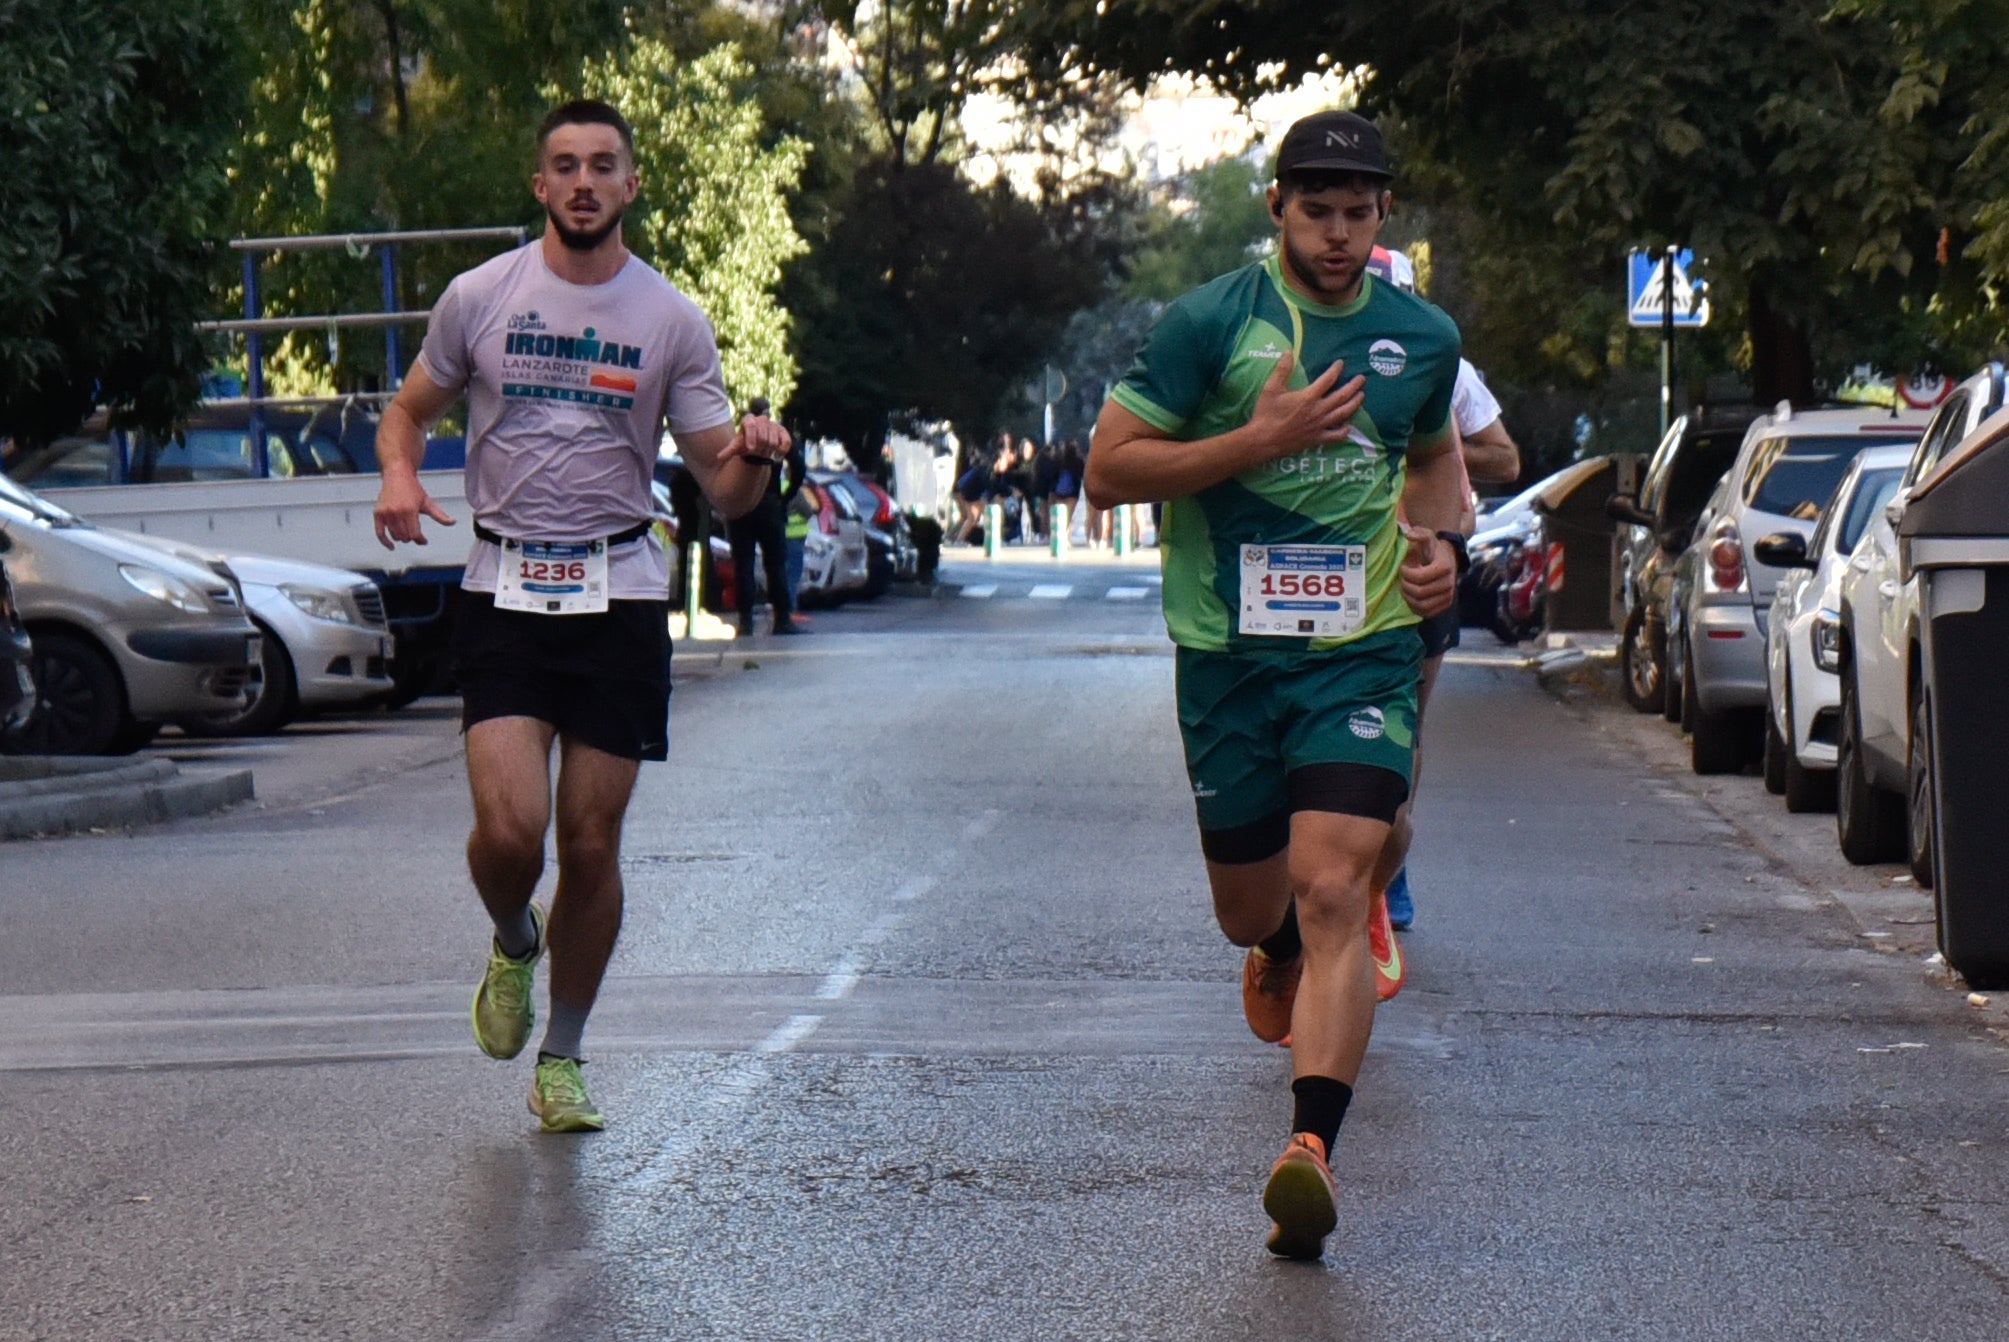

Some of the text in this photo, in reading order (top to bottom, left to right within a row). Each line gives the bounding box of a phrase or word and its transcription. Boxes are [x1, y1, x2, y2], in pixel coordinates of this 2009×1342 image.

[505, 327, 642, 369] IRONMAN
[502, 358, 589, 376] LANZAROTE
[501, 371, 588, 387] ISLAS CANARIAS
[515, 385, 621, 408] FINISHER
[519, 559, 586, 582] 1236
[1260, 573, 1345, 597] 1568
